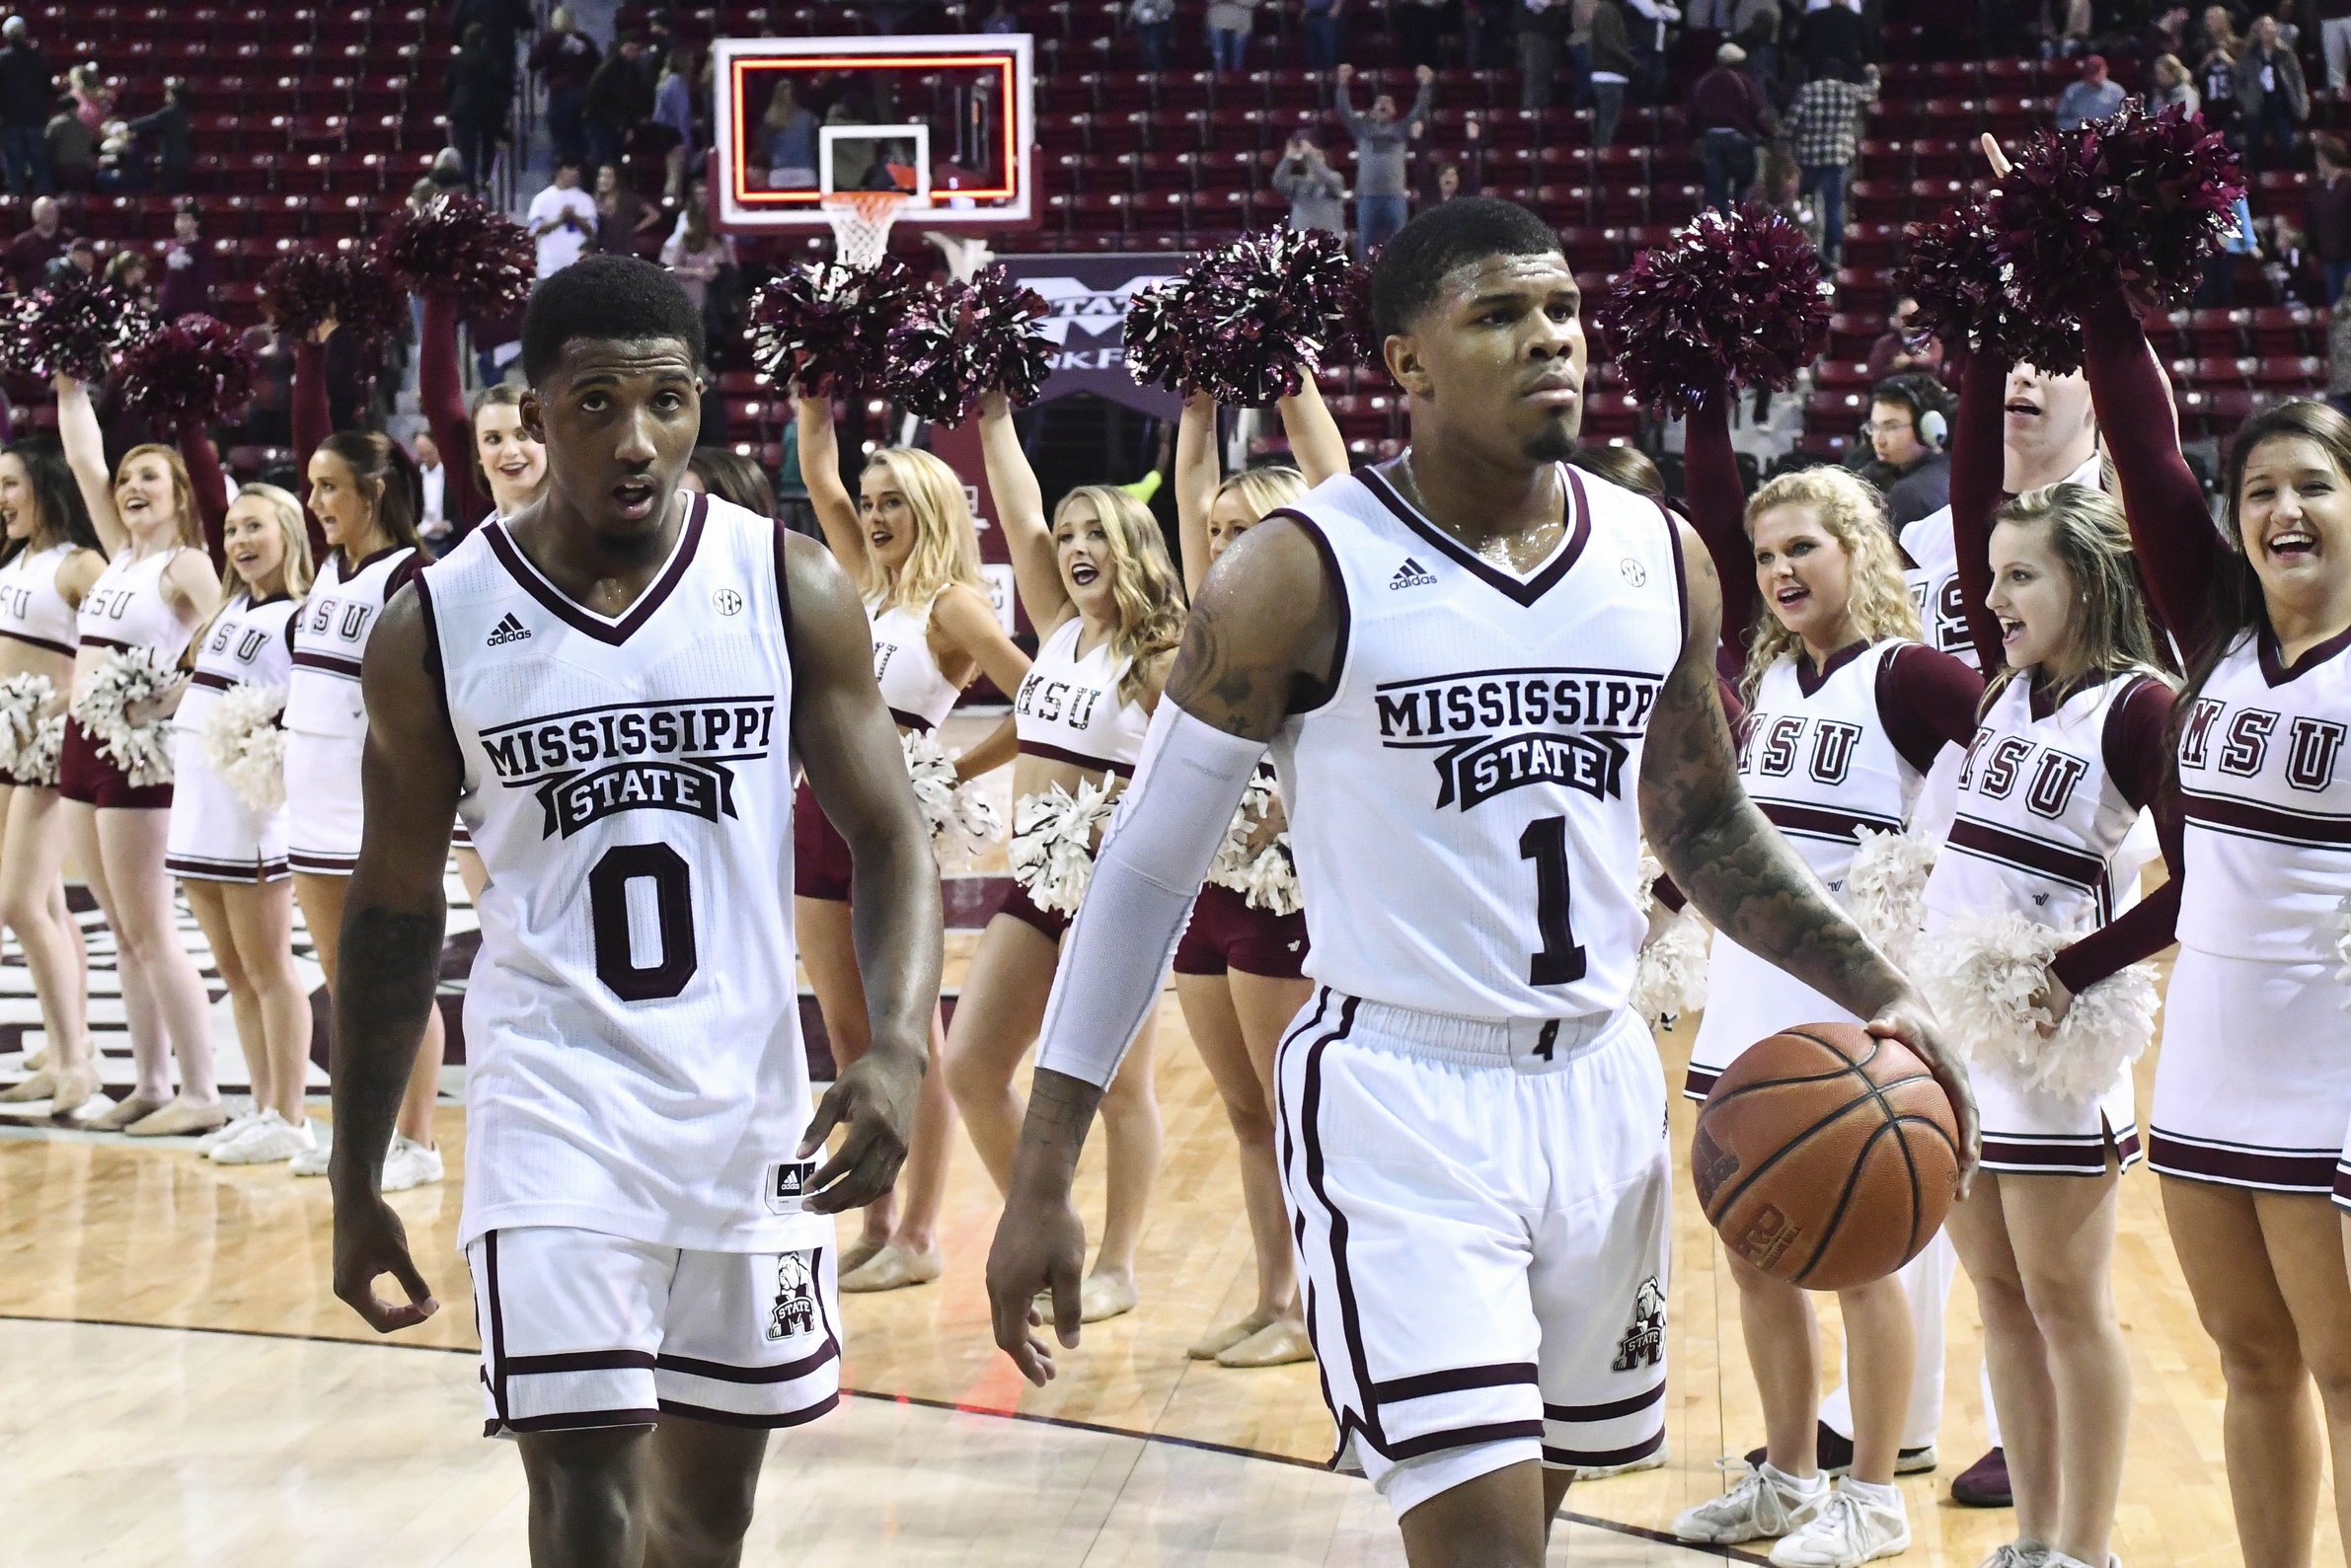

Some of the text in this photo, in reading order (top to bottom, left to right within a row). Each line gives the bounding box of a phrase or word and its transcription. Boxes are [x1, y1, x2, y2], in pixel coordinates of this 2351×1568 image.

[0, 585, 32, 620] SU
[713, 588, 742, 617] SEC
[1390, 574, 1438, 591] adidas
[203, 622, 272, 665] SU
[487, 630, 532, 647] adidas
[1017, 674, 1101, 730] MSU
[482, 706, 775, 778] MISSISSIPPI
[1474, 739, 1597, 793] STATE
[2178, 697, 2348, 793] MSU
[570, 769, 702, 823] STATE
[588, 842, 698, 1003] 0
[1518, 814, 1587, 987] 1
[778, 1300, 810, 1320] STATE
[1628, 1331, 1659, 1352] STATE
